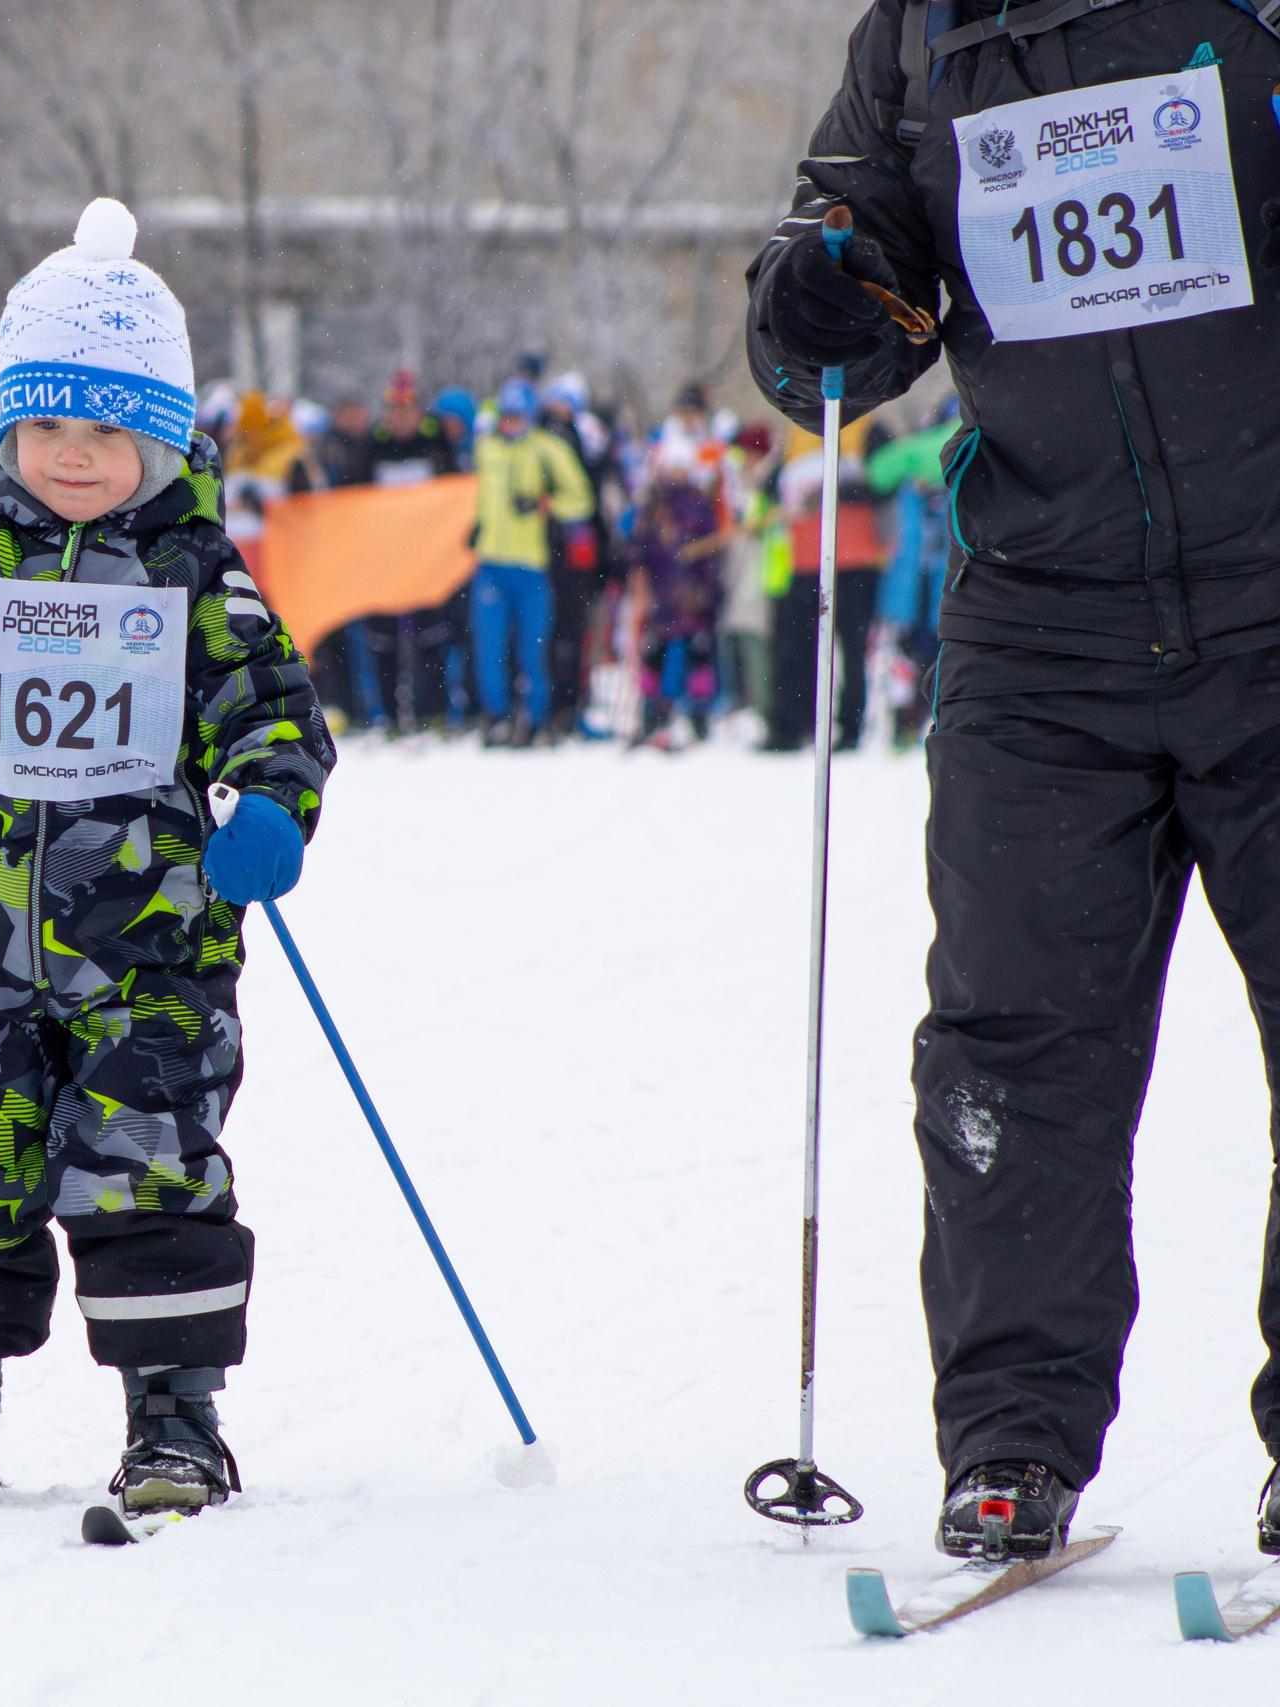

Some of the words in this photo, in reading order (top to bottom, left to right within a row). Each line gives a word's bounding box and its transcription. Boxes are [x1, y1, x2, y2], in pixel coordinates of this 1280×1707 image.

[1039, 107, 1129, 142] ЛЫЖНЯ
[1036, 124, 1134, 161] РОССИИ
[1054, 147, 1118, 176] 2025
[979, 169, 1023, 185] МИНСПОРТ
[983, 181, 1018, 194] РОССИИ
[1011, 183, 1185, 283] 1831
[1070, 286, 1141, 310] ОМСКАЯ
[1148, 272, 1231, 297] ОБЛАСТЬ
[145, 401, 190, 427] МИНСПОРТ
[149, 415, 182, 436] РОССИИ
[6, 599, 98, 621] ЛЫЖНЯ
[2, 616, 100, 639] РОССИИ
[17, 635, 82, 655] 2025
[13, 764, 78, 779] ОМСКАЯ
[85, 758, 156, 777] ОБЛАСТЬ
